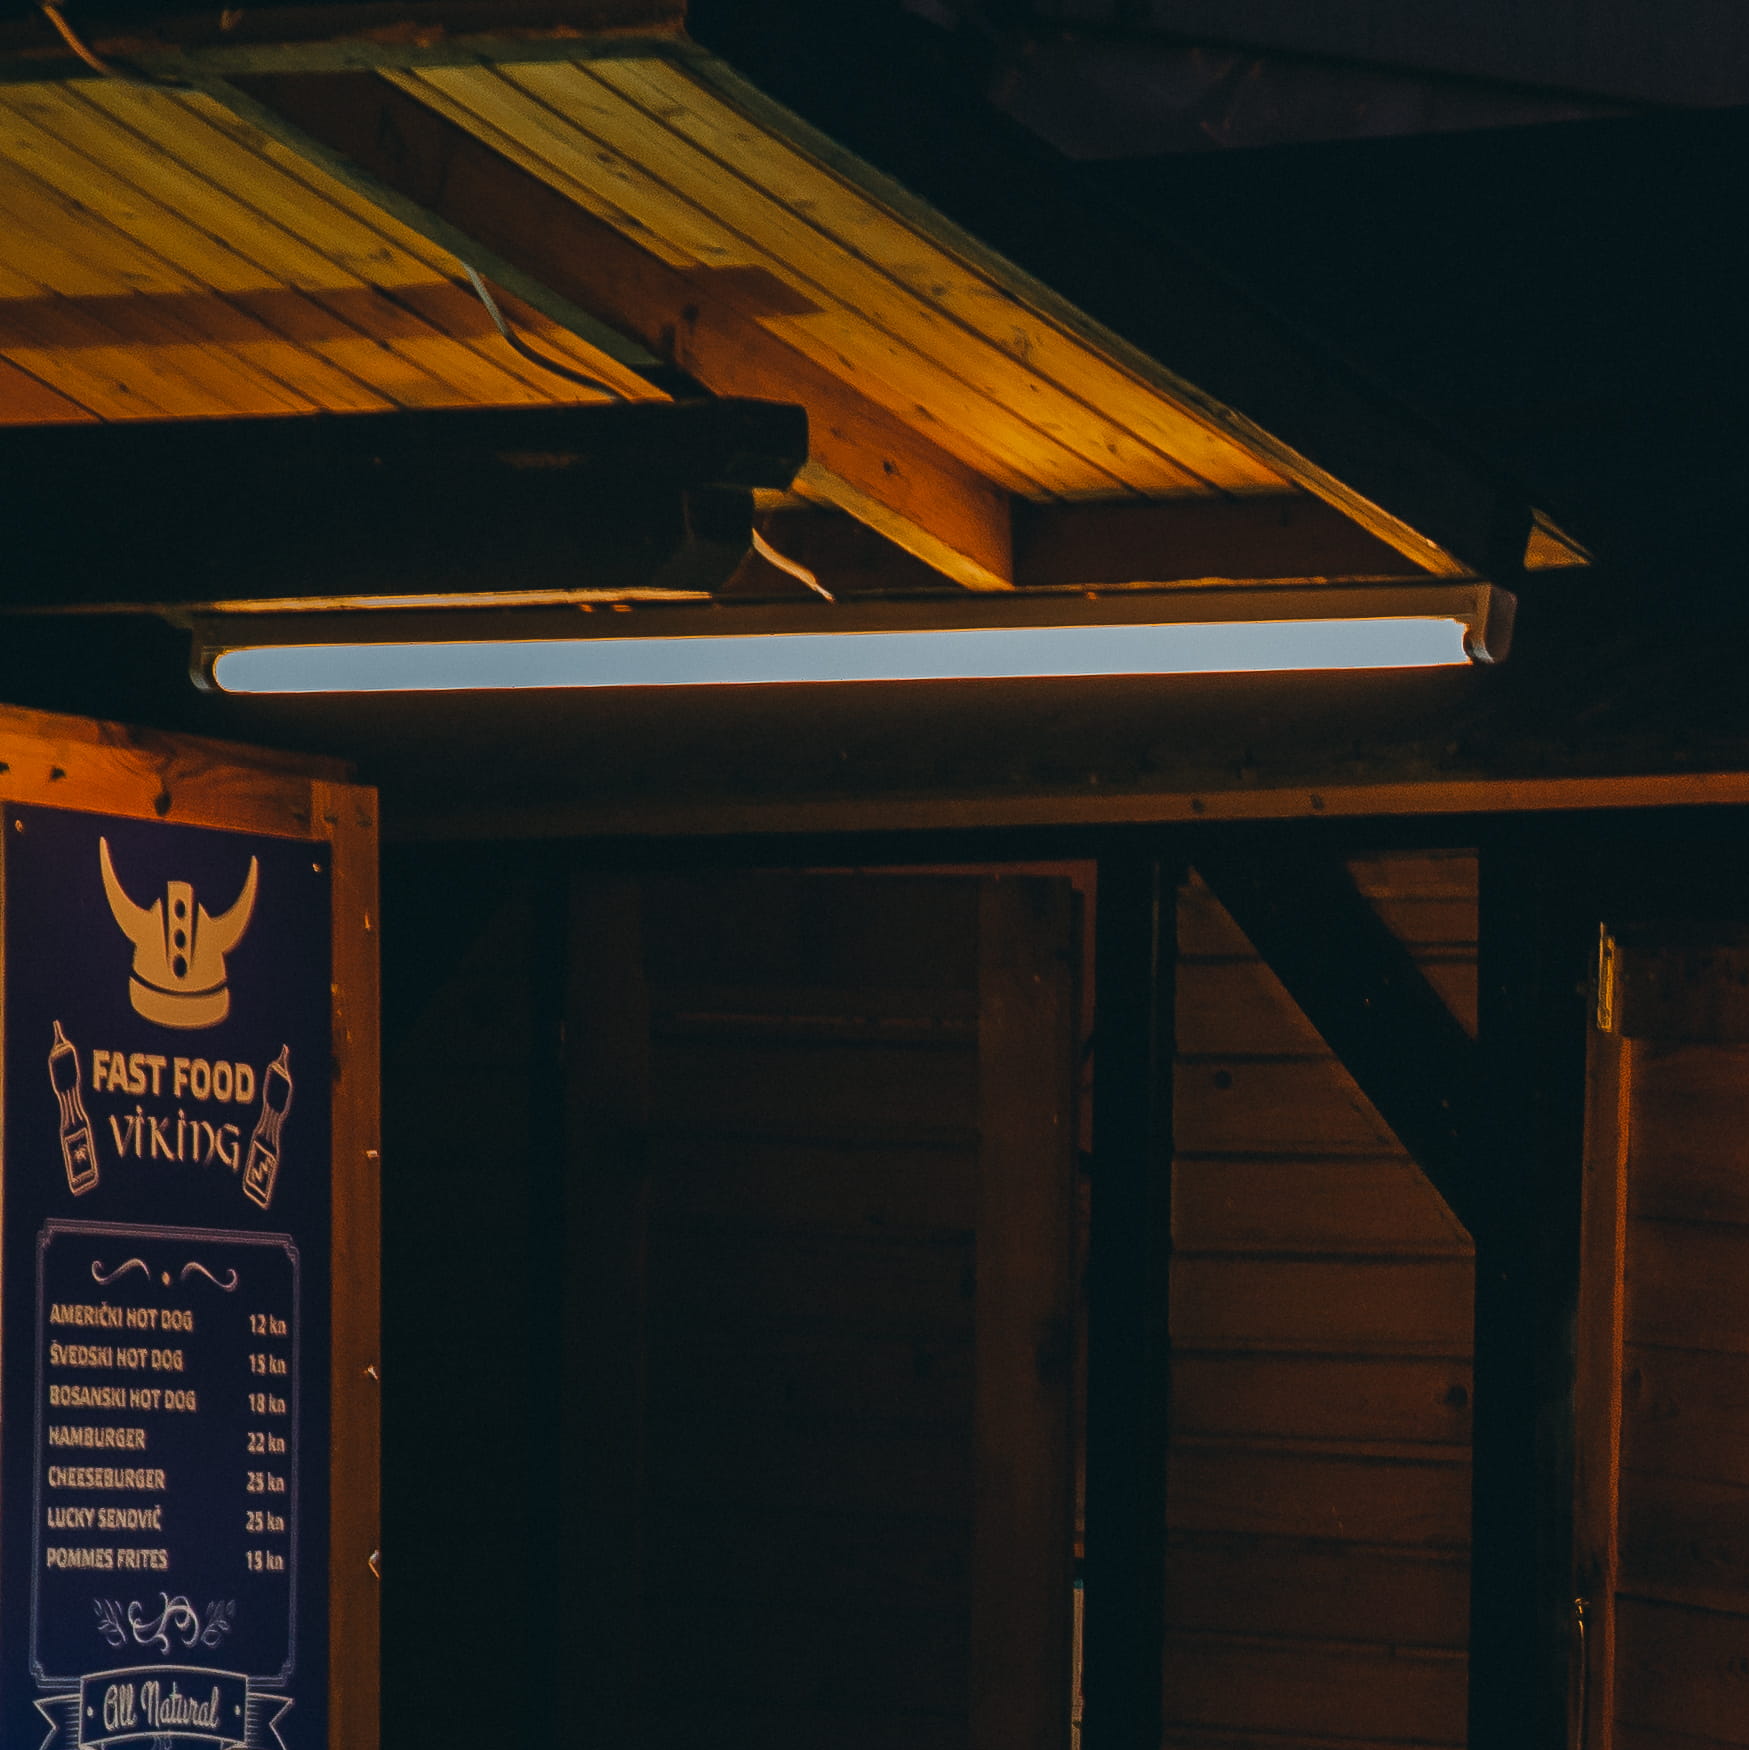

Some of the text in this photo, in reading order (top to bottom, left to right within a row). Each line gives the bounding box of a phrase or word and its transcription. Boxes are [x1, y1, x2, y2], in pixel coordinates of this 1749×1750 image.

[92, 1049, 256, 1105] FAST FOOD
[50, 1301, 193, 1332] AMERIČKI HOT DOG
[50, 1340, 184, 1371] ŠVEDSKI HOT DOG
[50, 1385, 197, 1412] BOSANSKI HOT DOG
[49, 1426, 146, 1450] HAMBURGER
[48, 1466, 166, 1490] CHEESEBURGER
[47, 1507, 94, 1529] LUCKY
[46, 1547, 169, 1571] POMMES FRITES
[103, 1680, 221, 1730] All Natural
